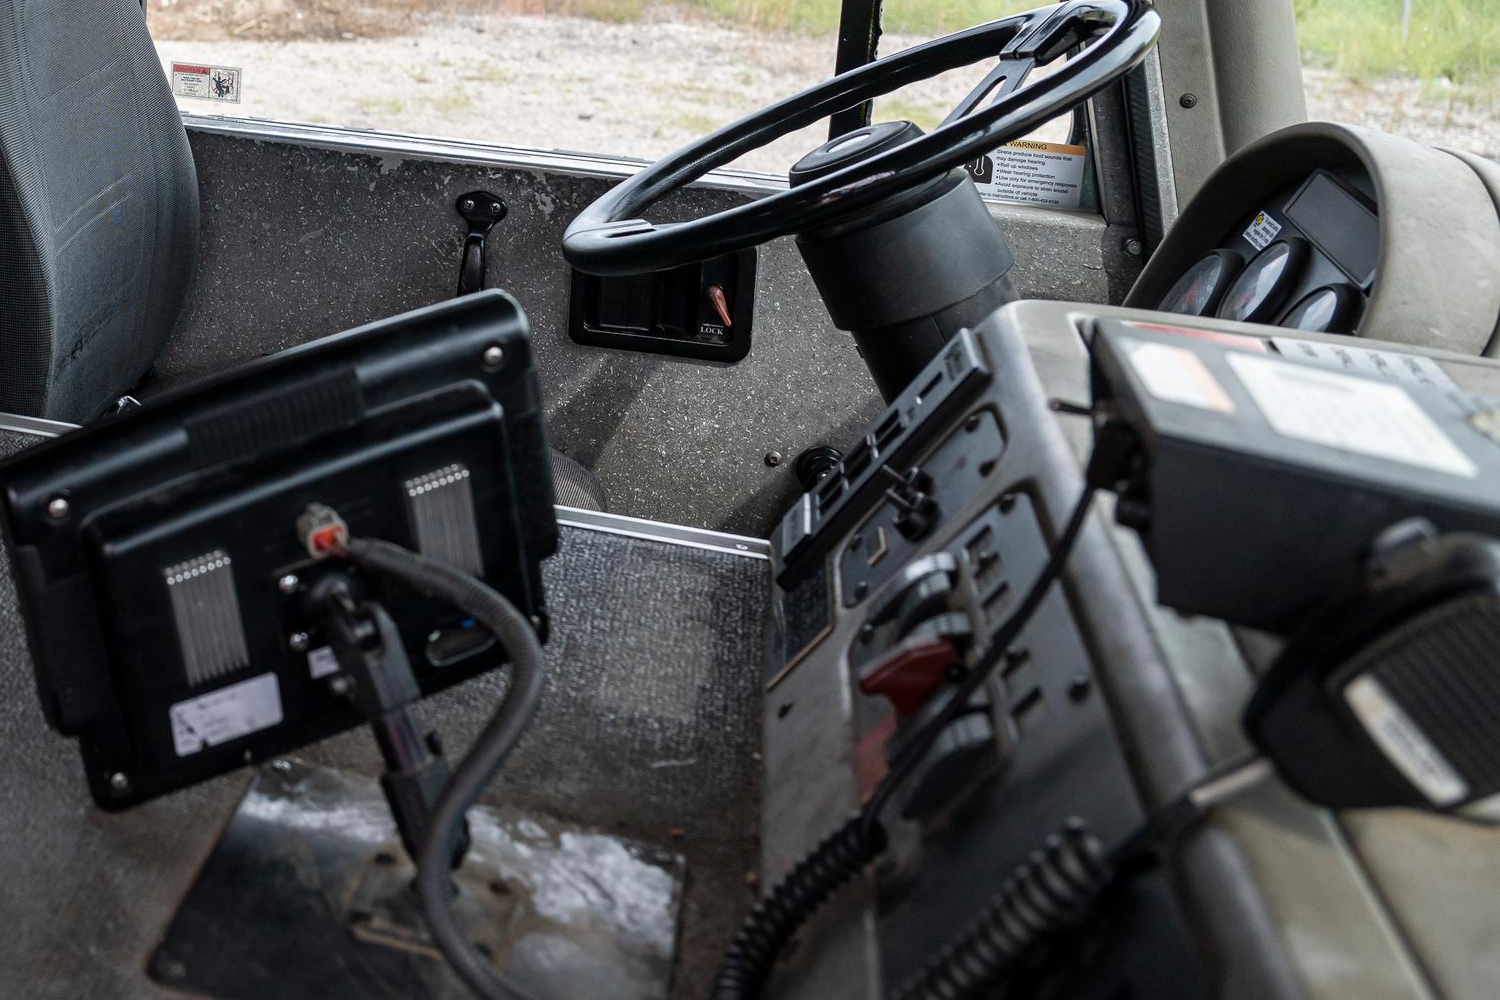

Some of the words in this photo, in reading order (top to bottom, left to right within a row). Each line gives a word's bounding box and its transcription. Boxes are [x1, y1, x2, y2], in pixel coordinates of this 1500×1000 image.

[1010, 141, 1048, 150] WARNING
[1027, 158, 1045, 166] hearing
[700, 326, 723, 335] LOCK
